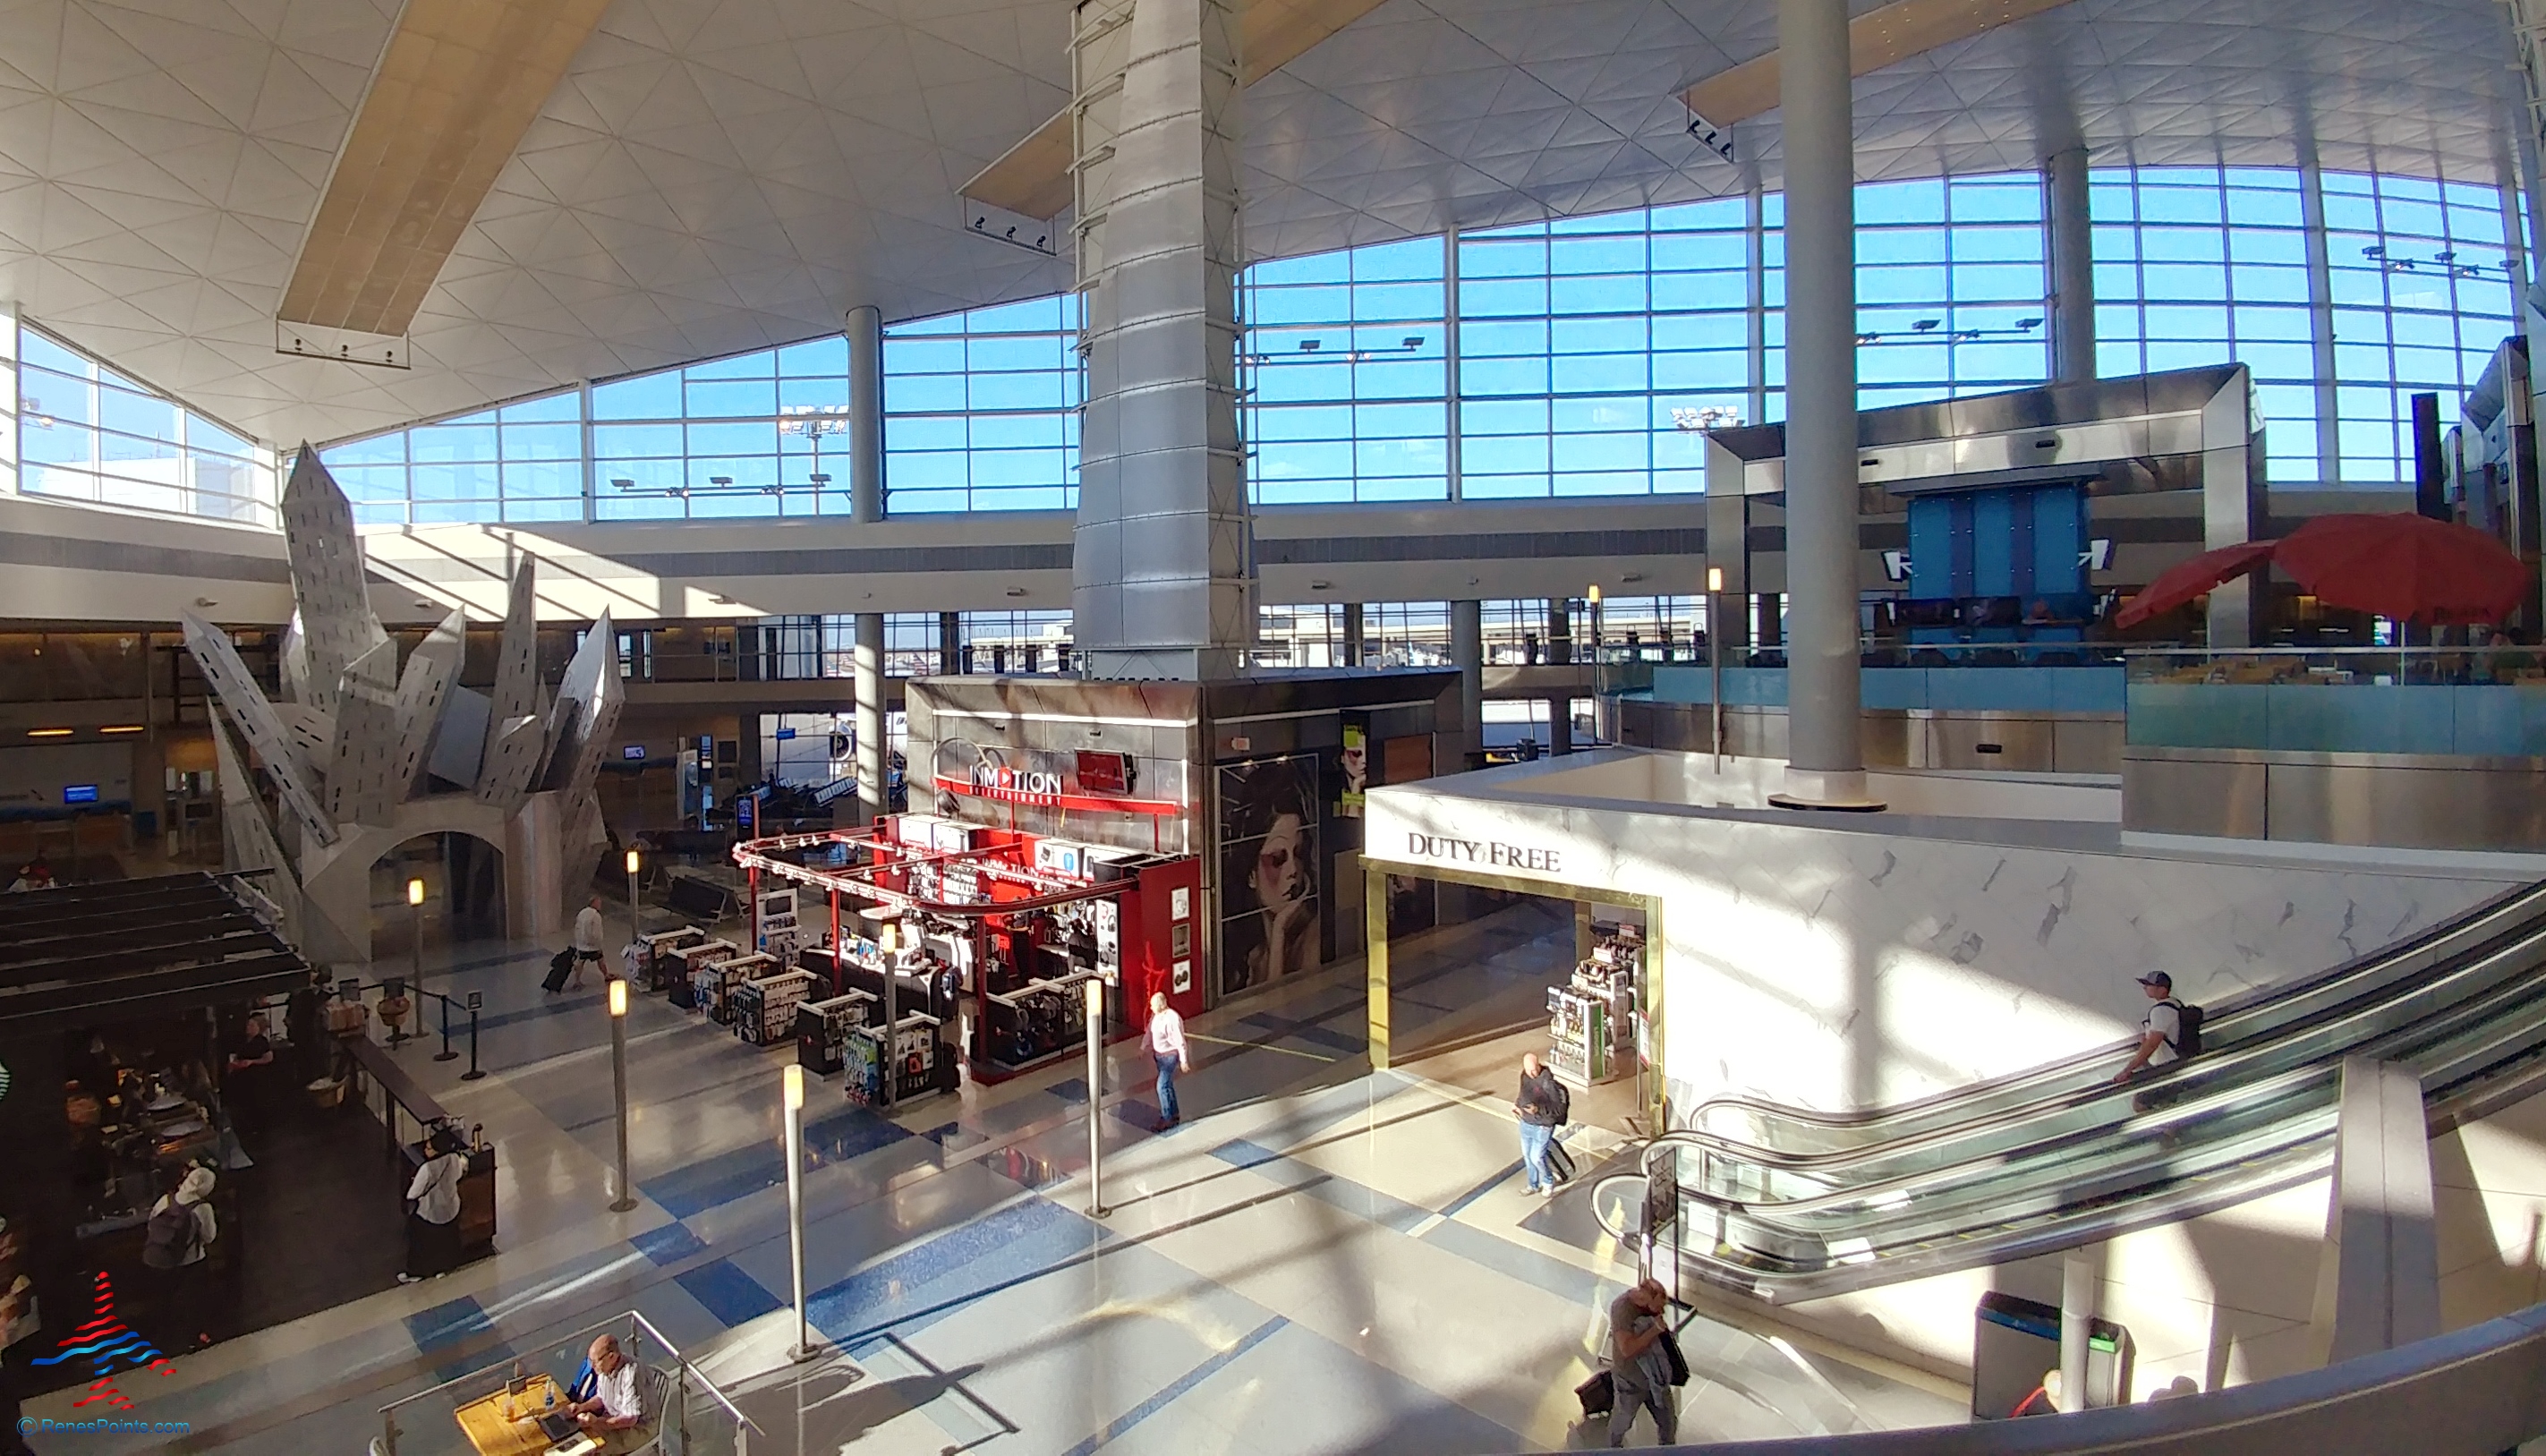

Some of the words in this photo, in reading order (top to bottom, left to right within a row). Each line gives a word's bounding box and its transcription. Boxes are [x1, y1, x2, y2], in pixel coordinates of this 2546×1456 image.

[969, 765, 1062, 796] INMOTION
[1408, 832, 1482, 862] DUTY
[1489, 841, 1562, 873] FREE
